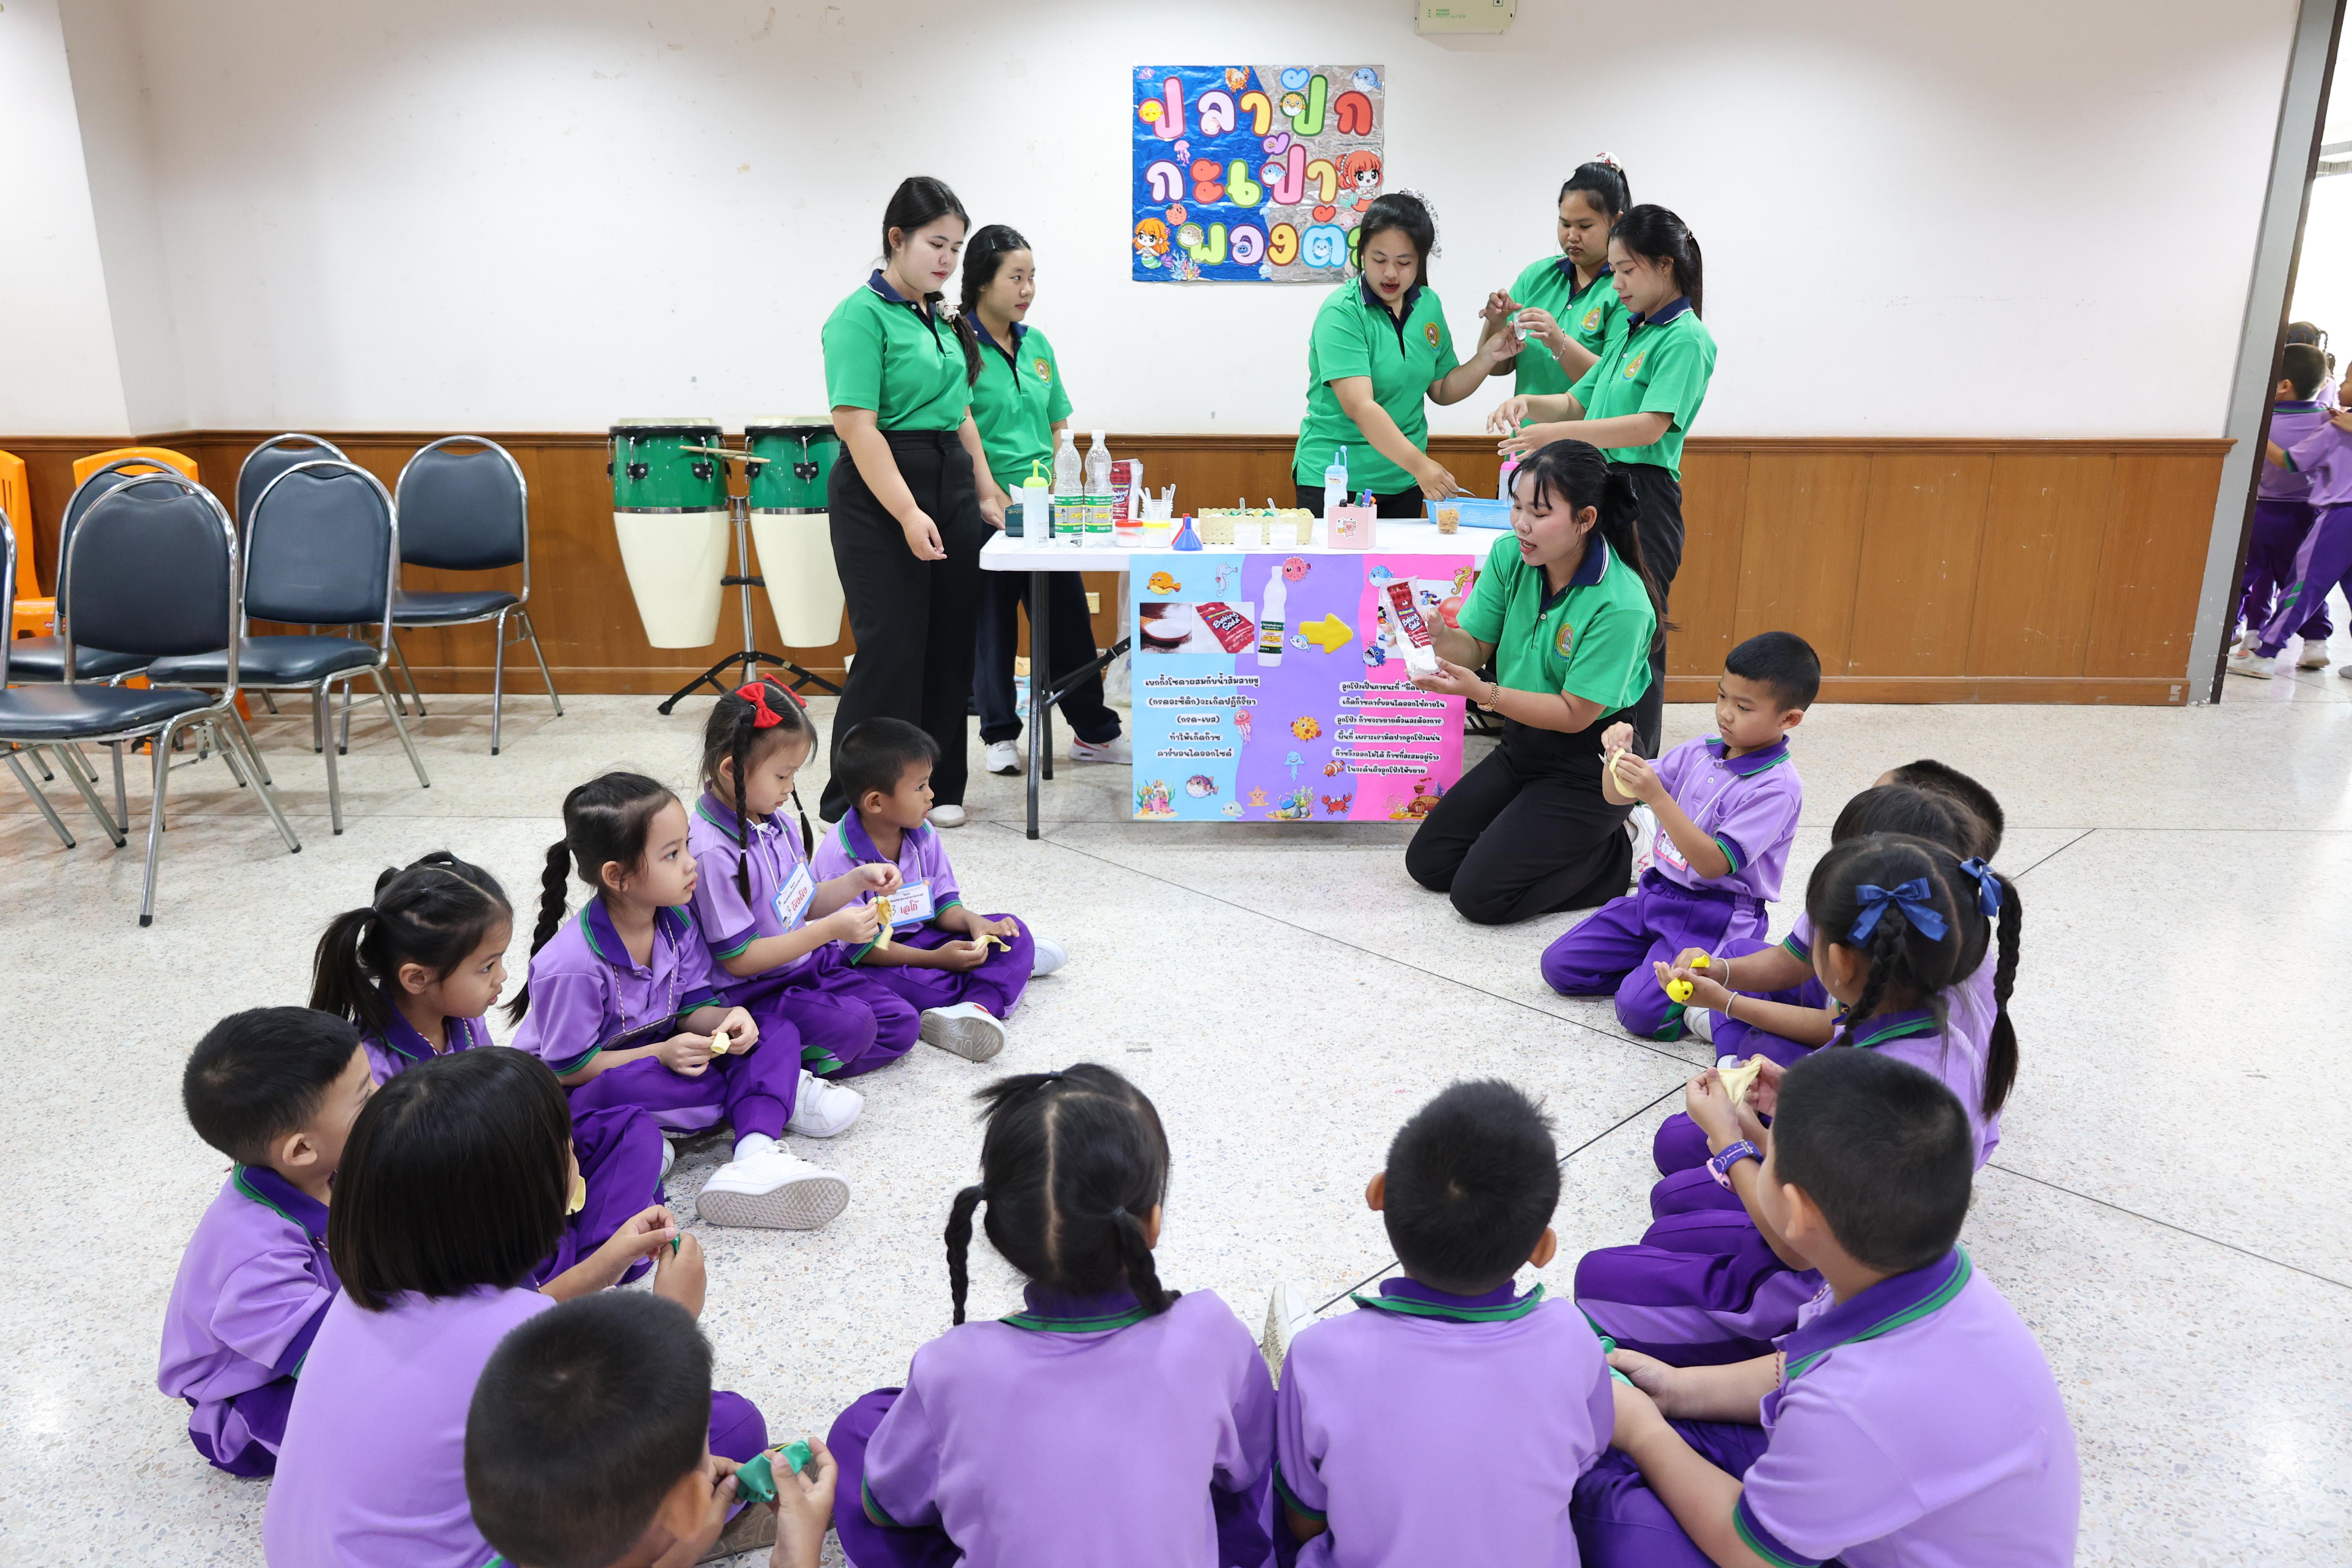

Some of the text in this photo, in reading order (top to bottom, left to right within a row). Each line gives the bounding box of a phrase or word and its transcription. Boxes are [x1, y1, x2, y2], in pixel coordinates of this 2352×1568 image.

[1212, 612, 1239, 629] Baking
[1222, 617, 1241, 631] Soda
[1402, 613, 1420, 626] Baking
[1408, 621, 1421, 631] Soda
[1342, 681, 1399, 691] ลูกโป่งเป็นภาชนะที่
[1337, 715, 1441, 725] ลูกโป่ง ก๊าซจะขยายตัวและต้องการ
[1169, 732, 1221, 740] ทำให้เกิดก๊าซ
[1338, 730, 1440, 743] พื้นที่ เพราะเรามัดปากลูกโป่งแน่น
[1157, 748, 1232, 757] คาร์บอนไดออกไซด์
[1336, 749, 1439, 762] ก๊าซจึงออกไม่ได้ ก๊าซที่สะสมอยู่ข้าง
[1347, 765, 1425, 775] ในจะดันผิวลูกโป่งให้ขยาย
